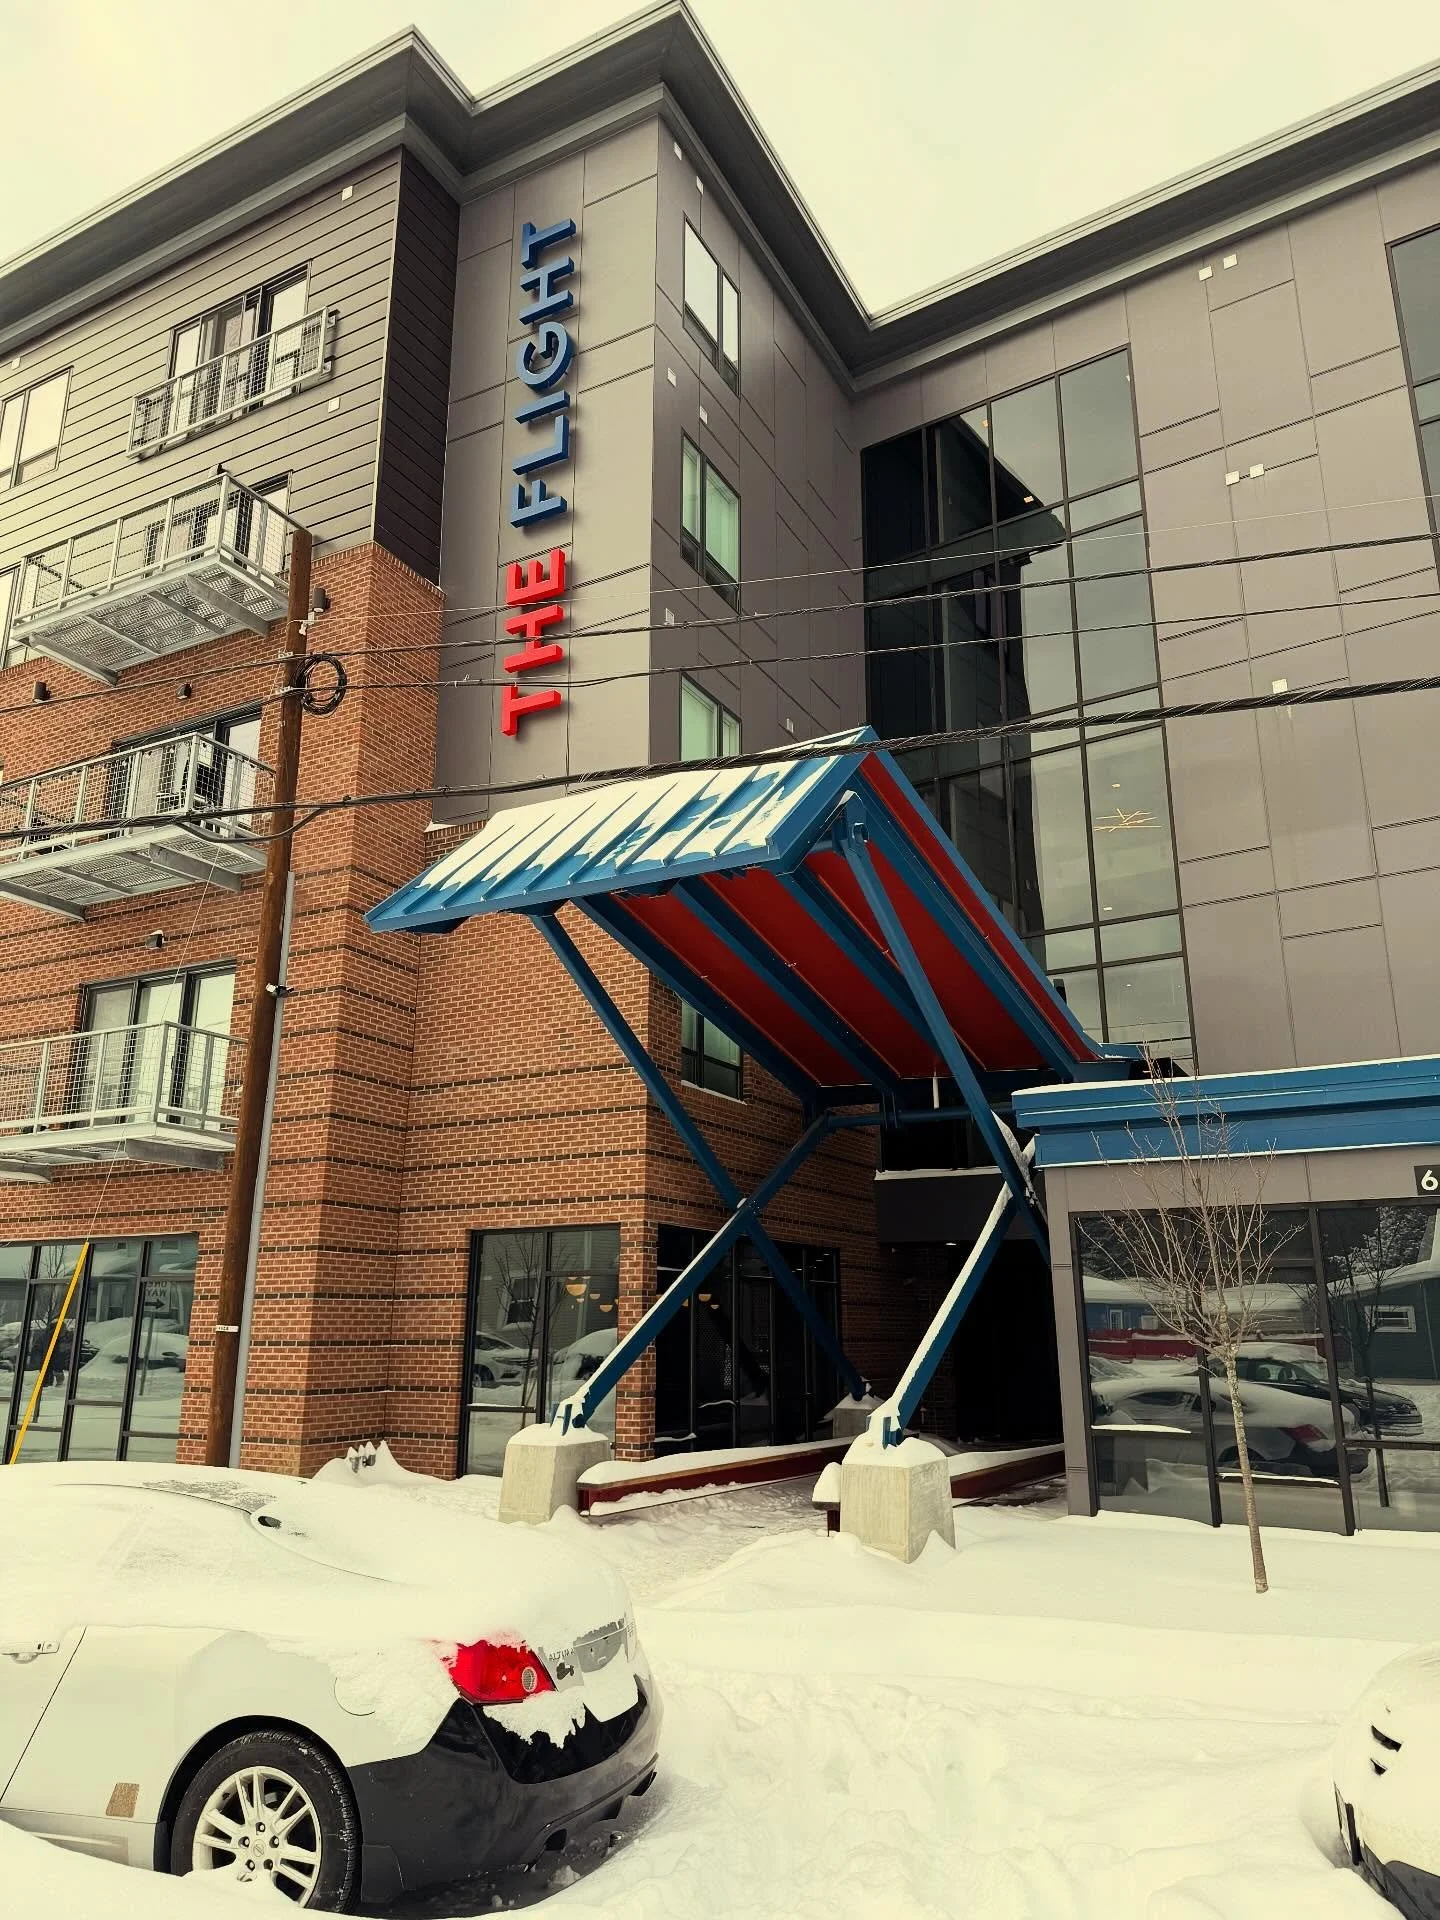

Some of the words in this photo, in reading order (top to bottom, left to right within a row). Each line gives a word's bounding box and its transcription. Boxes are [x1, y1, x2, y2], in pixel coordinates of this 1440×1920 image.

[510, 219, 577, 528] FLIGHT
[502, 548, 566, 737] THE
[1421, 1169, 1439, 1191] 6
